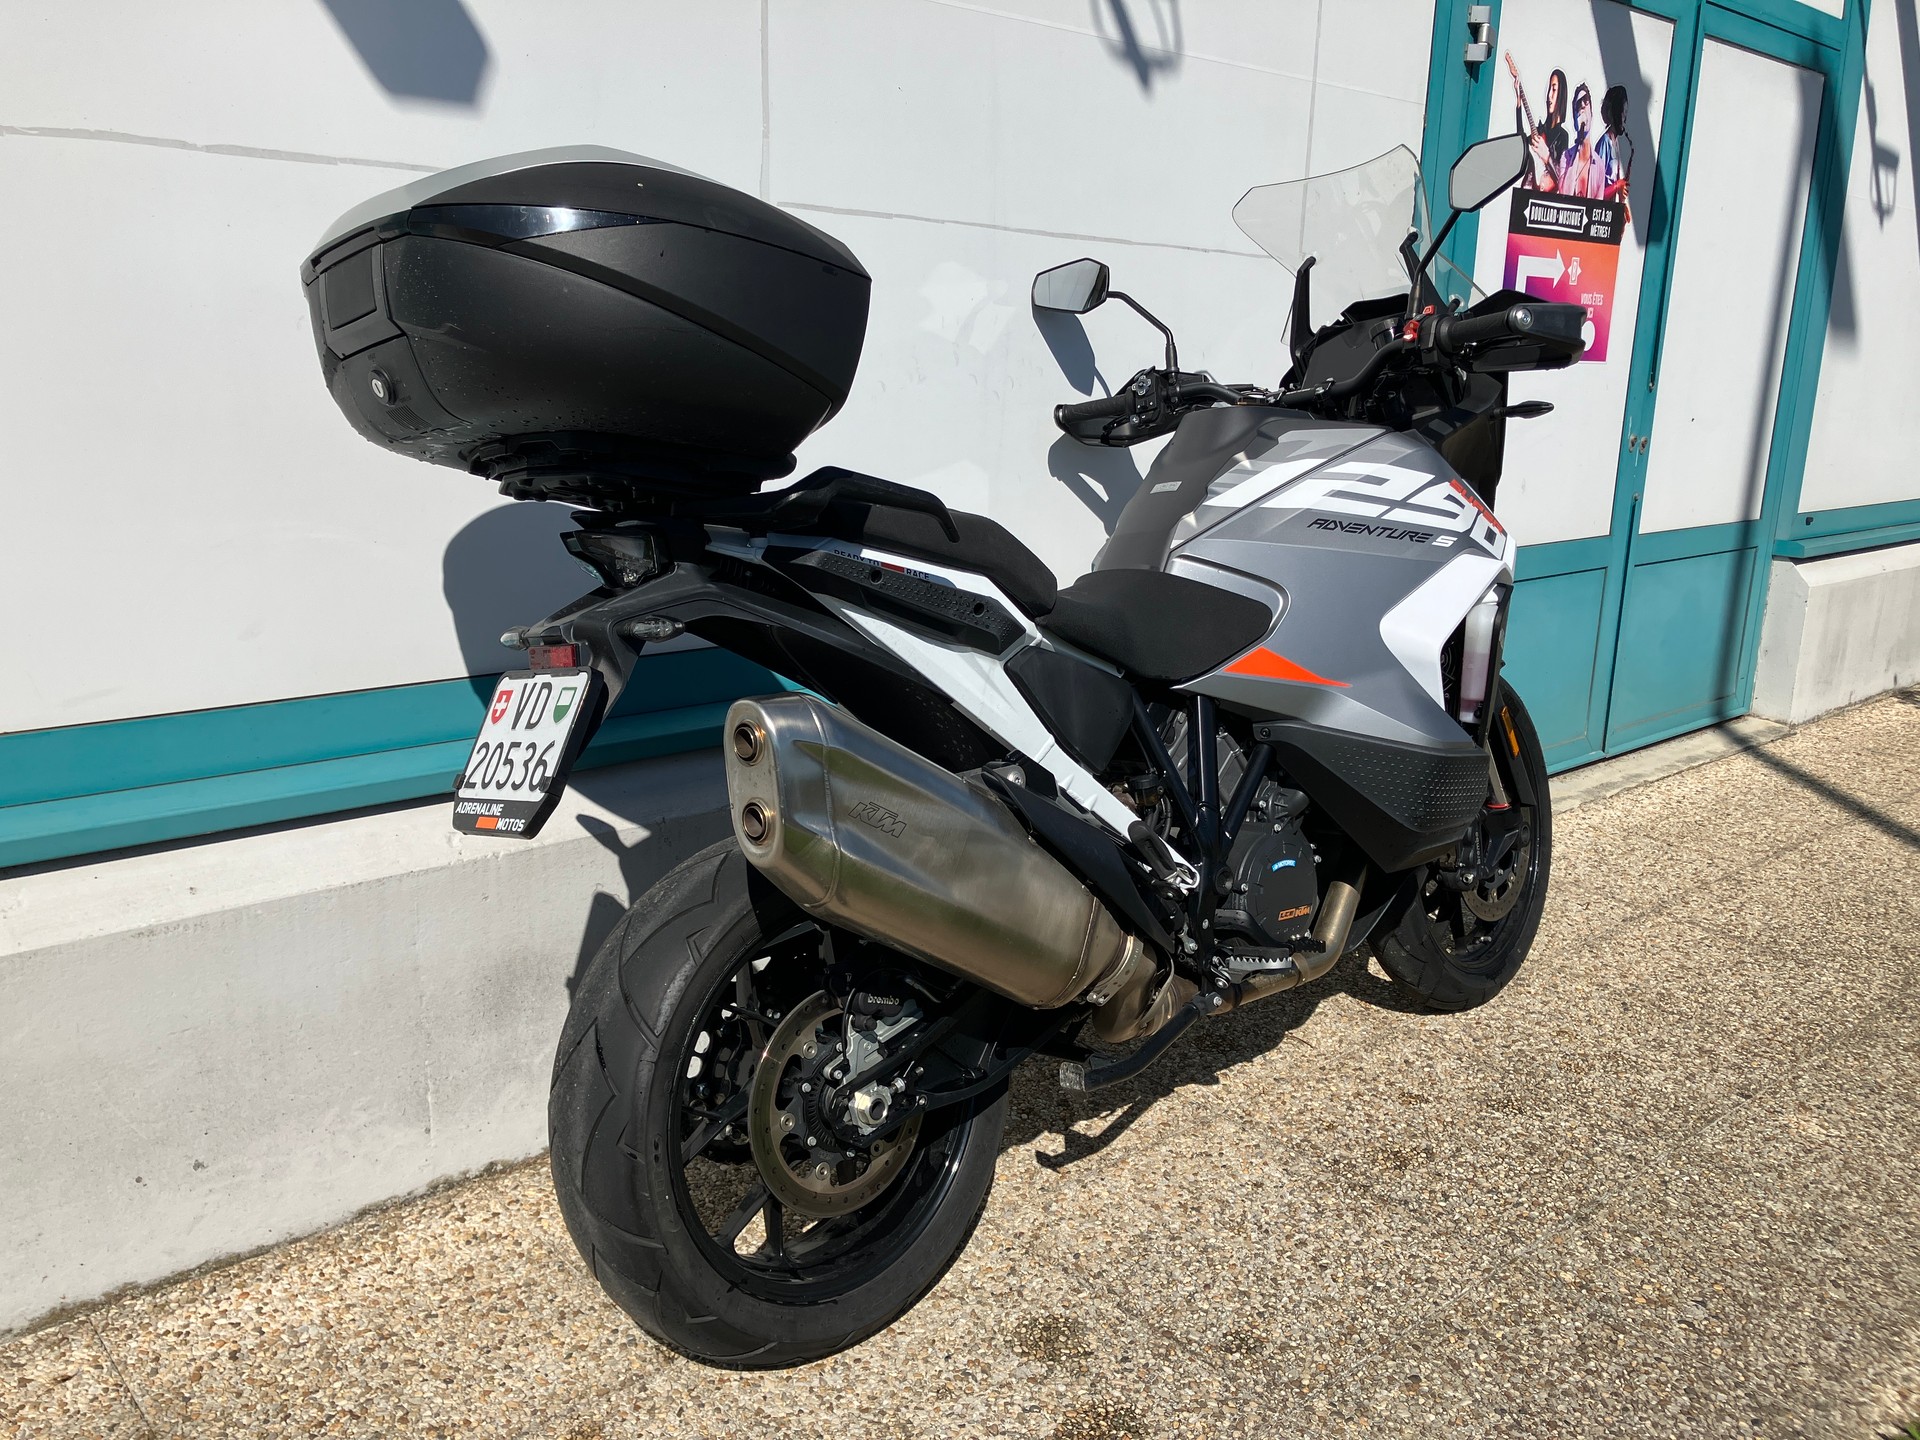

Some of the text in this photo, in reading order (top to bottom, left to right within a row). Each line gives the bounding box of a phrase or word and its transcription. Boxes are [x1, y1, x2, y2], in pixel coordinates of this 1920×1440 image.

[1592, 208, 1601, 221] EST
[1605, 210, 1612, 222] 30
[1580, 291, 1604, 306] VOUS ÊTES
[1202, 458, 1507, 561] 1290
[1449, 479, 1503, 535] SUPER
[1306, 517, 1459, 548] ADVENTURE S
[906, 568, 930, 581] RACE
[511, 681, 553, 730] VD
[463, 740, 556, 793] 20536
[455, 801, 504, 816] ADRENALINE
[848, 801, 907, 839] KTM
[496, 817, 526, 832] MOTOS
[867, 993, 900, 1006] brembo
